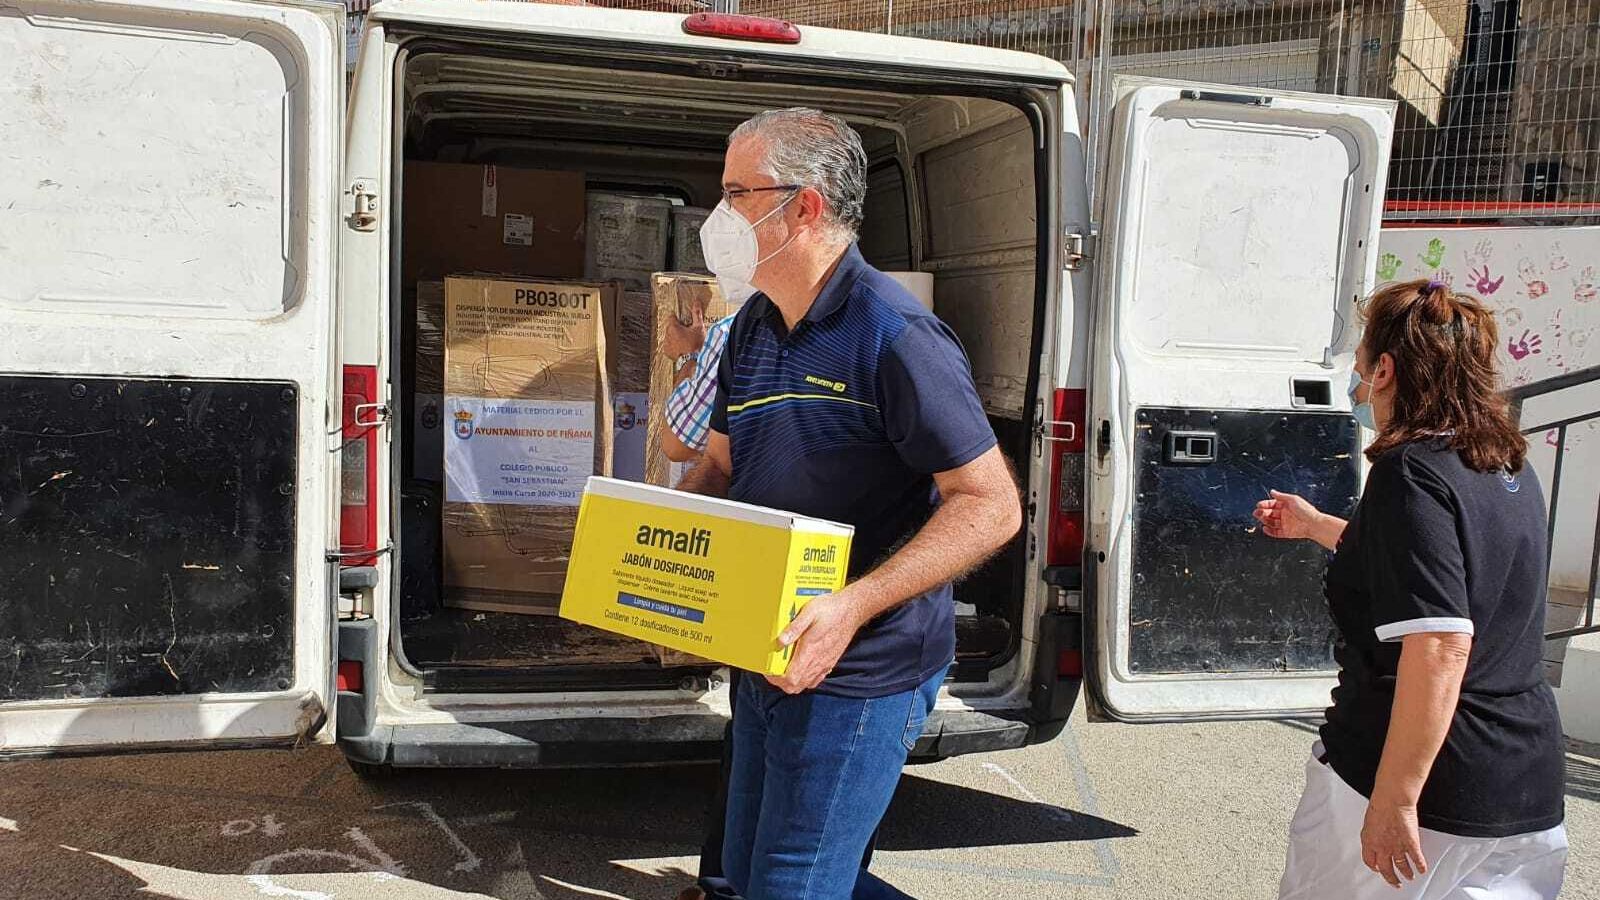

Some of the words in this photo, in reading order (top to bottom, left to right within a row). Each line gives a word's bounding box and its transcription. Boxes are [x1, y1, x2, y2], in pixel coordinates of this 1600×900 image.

[515, 289, 591, 310] PB0300T
[533, 309, 569, 319] INDUSTRIAL
[482, 405, 522, 415] MATERIAL
[524, 407, 556, 416] CEDIDO
[556, 408, 574, 416] POR
[474, 427, 544, 438] AYUNTAMIENTO
[546, 429, 559, 438] DE
[560, 428, 593, 439] FIÑANA
[528, 445, 539, 453] AL
[500, 463, 534, 471] COLEGIO
[514, 489, 536, 497] Curso
[636, 525, 711, 558] amalfi
[803, 544, 837, 563] amalfi
[621, 552, 652, 569] JABÓN
[653, 557, 715, 583] DOSIFICADOR
[604, 609, 630, 623] Contiene
[631, 616, 639, 626] 12
[640, 618, 680, 637] dosificadores
[680, 628, 689, 638] de
[690, 630, 703, 641] 500
